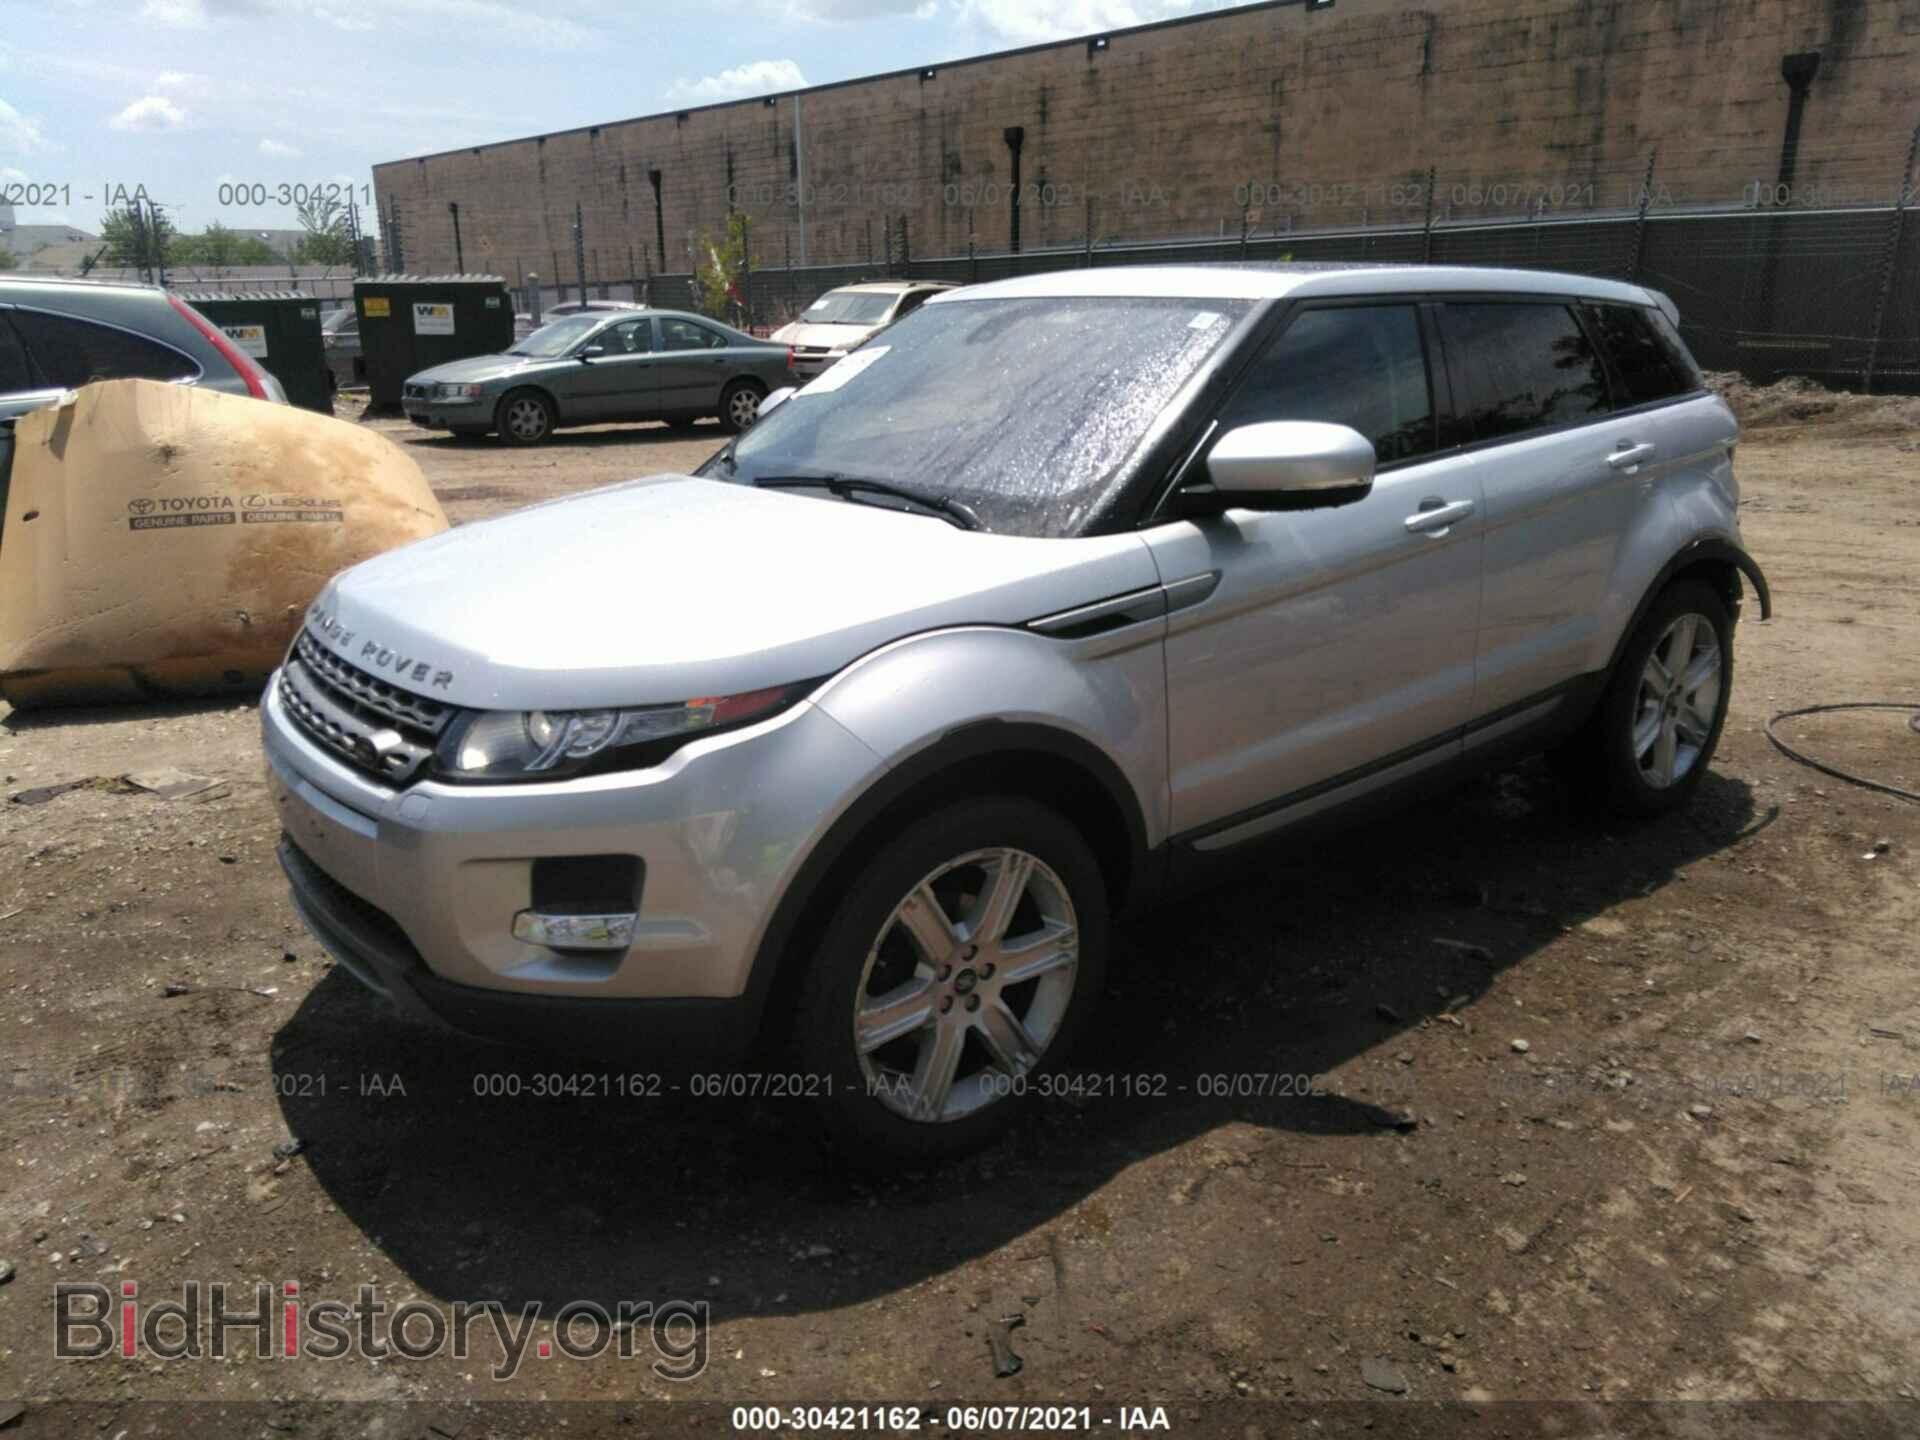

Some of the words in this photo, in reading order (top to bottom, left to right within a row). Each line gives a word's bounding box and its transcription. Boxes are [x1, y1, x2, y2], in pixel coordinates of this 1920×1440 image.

[159, 496, 234, 511] TOYOTA
[134, 515, 189, 529] GENUINE
[191, 512, 232, 526] PARTS
[361, 640, 454, 690] ROVER
